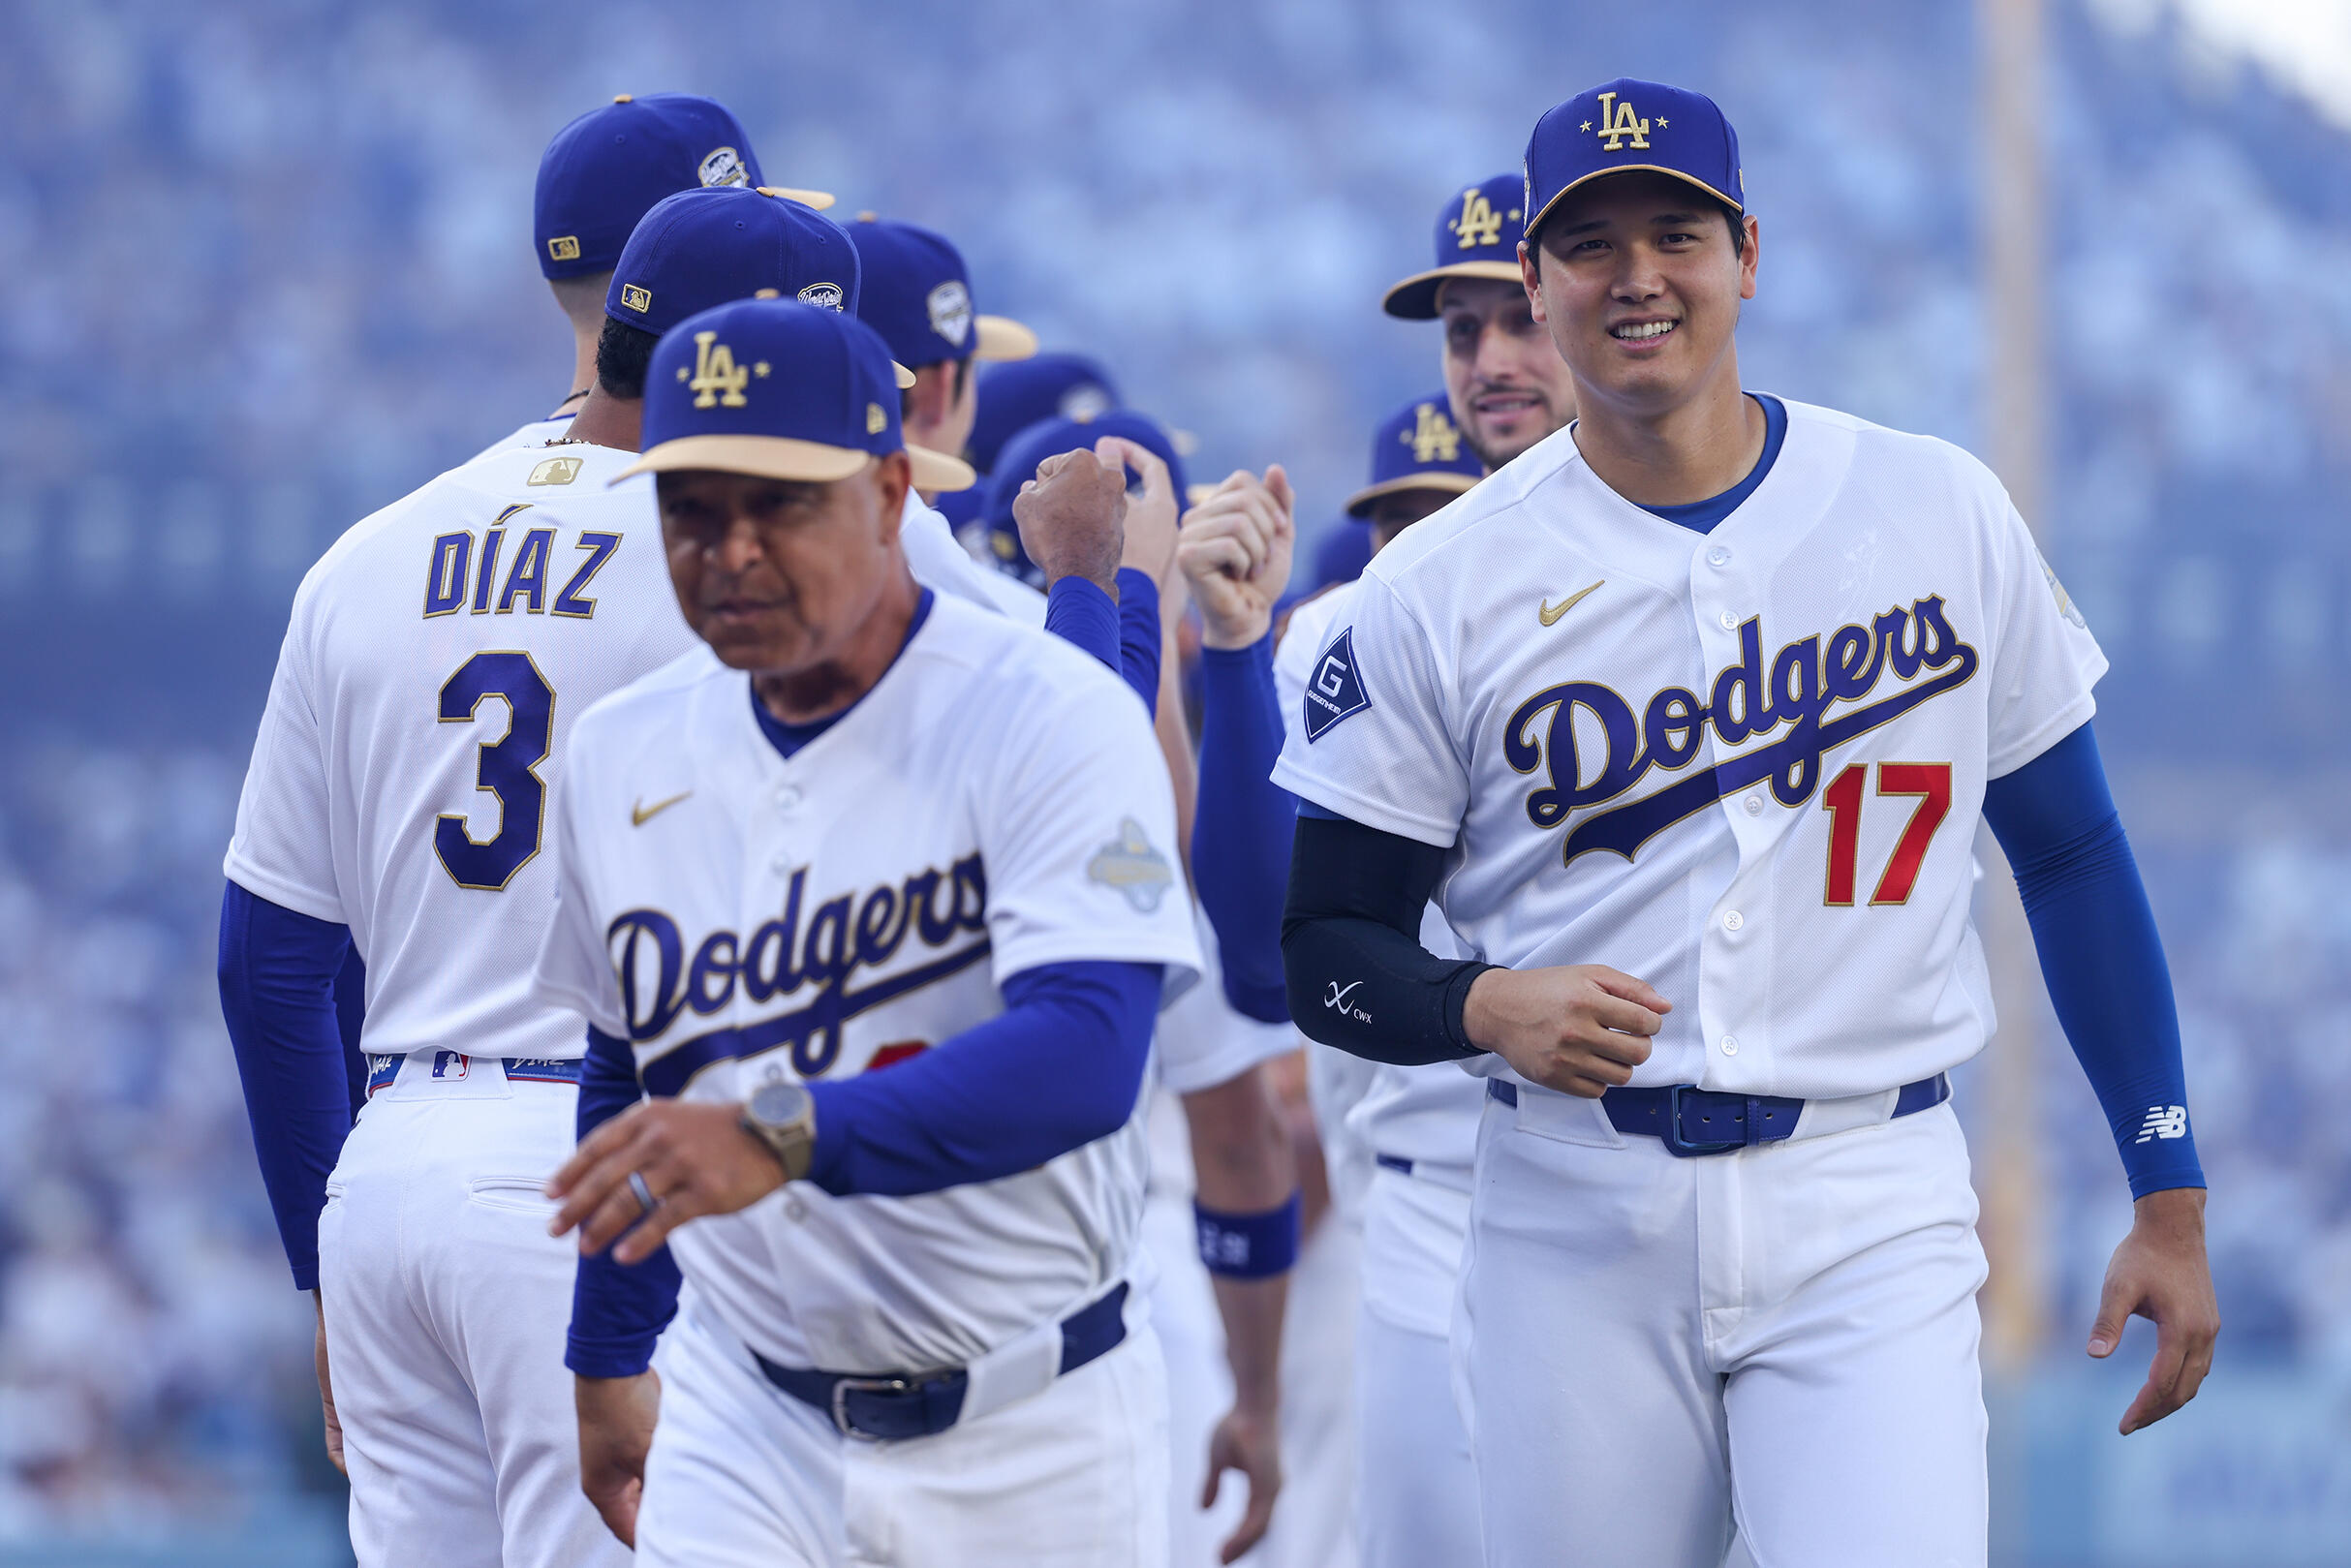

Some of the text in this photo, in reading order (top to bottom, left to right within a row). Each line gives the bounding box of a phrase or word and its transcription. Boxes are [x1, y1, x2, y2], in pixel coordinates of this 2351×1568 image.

[1597, 92, 1650, 150] LA
[1456, 188, 1501, 250] LA
[689, 330, 749, 409] LA
[1411, 402, 1460, 462] LA
[423, 504, 624, 620] DÍAZ
[1317, 655, 1347, 698] G
[1504, 594, 1978, 838] Dodgers
[433, 650, 557, 891] 3
[1822, 761, 1953, 907] 17
[606, 851, 990, 1077] Dodgers
